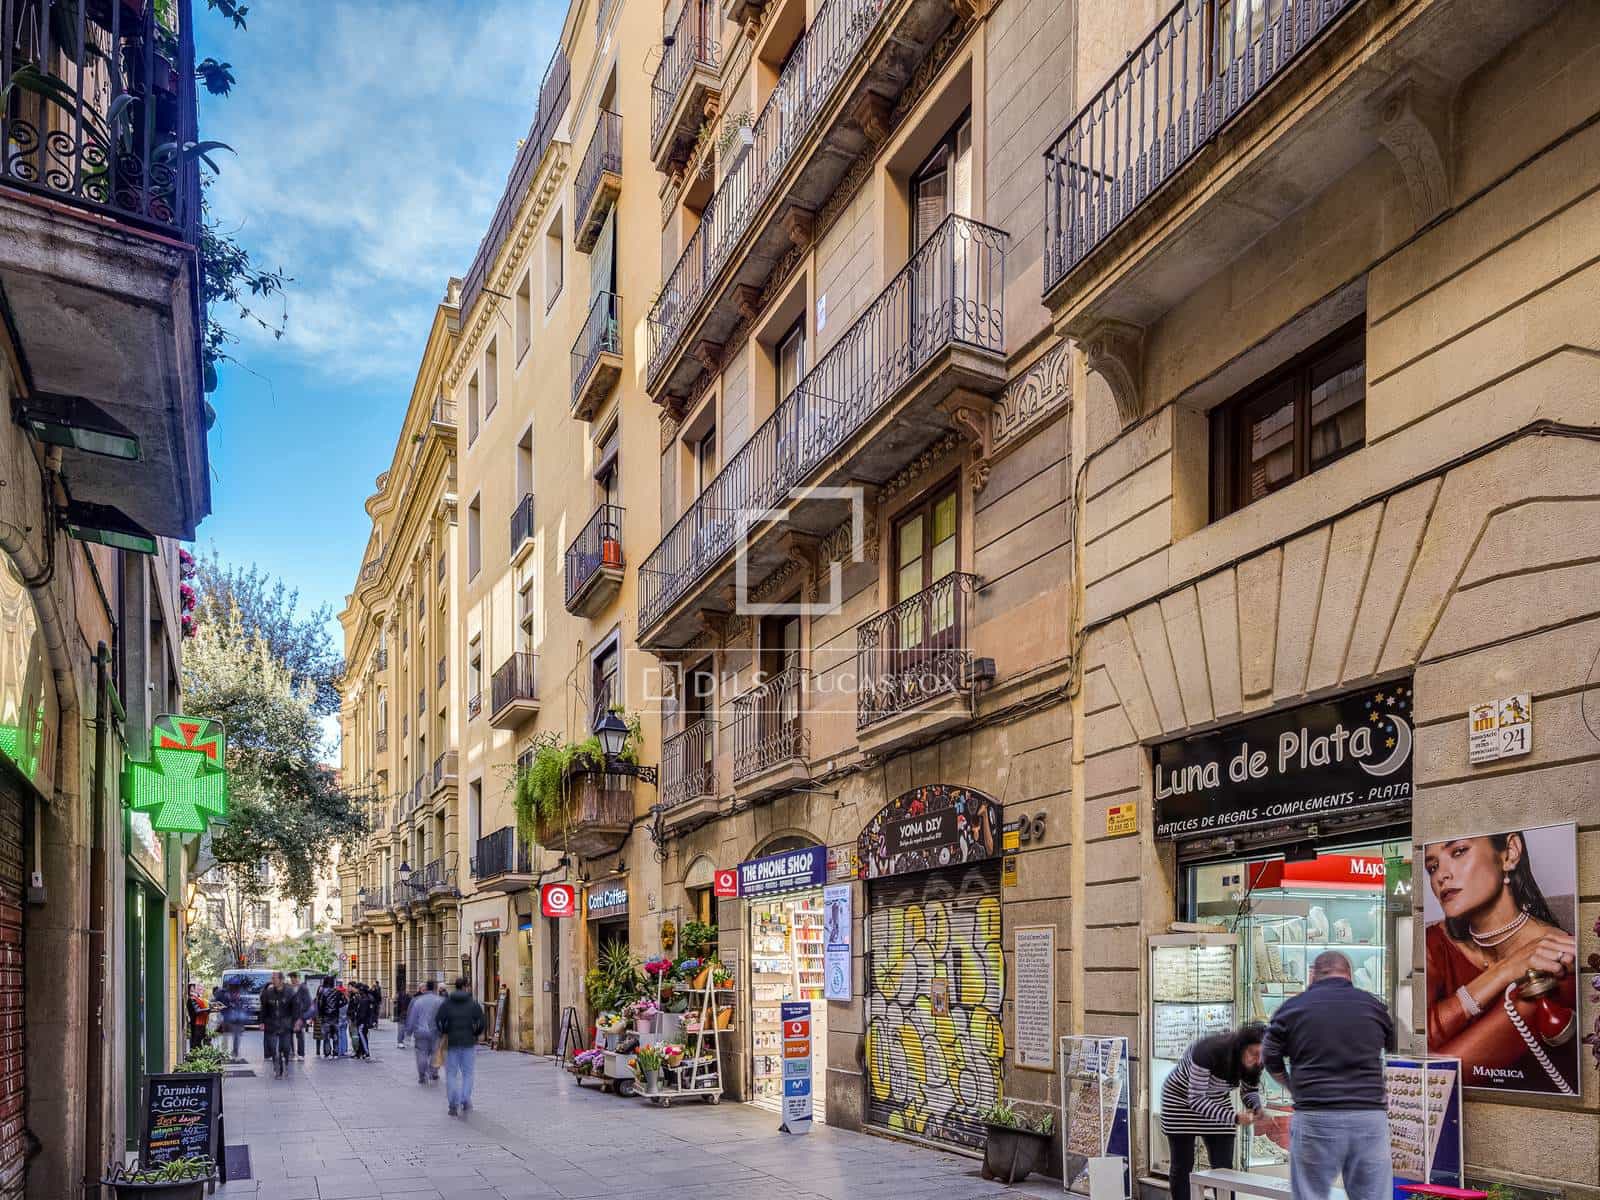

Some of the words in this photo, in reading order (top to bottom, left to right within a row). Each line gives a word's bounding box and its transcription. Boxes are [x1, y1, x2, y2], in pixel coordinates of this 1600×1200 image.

[1503, 728, 1525, 753] 24
[1155, 761, 1220, 800] Luna
[1228, 742, 1269, 783] de
[1278, 723, 1373, 774] Plata
[1157, 819, 1199, 835] ARTICLES
[1201, 815, 1215, 828] DE
[1217, 807, 1258, 825] REGALS
[1368, 782, 1411, 801] PLATA
[899, 821, 923, 839] YONA
[925, 816, 942, 833] DIY
[1018, 808, 1047, 841] 26
[742, 863, 757, 883] THE
[757, 857, 786, 880] PHONE
[787, 852, 813, 874] SHOP
[604, 888, 627, 907] Coffee
[1472, 1064, 1525, 1079] MAJORICA
[161, 1096, 199, 1108] Gòtic
